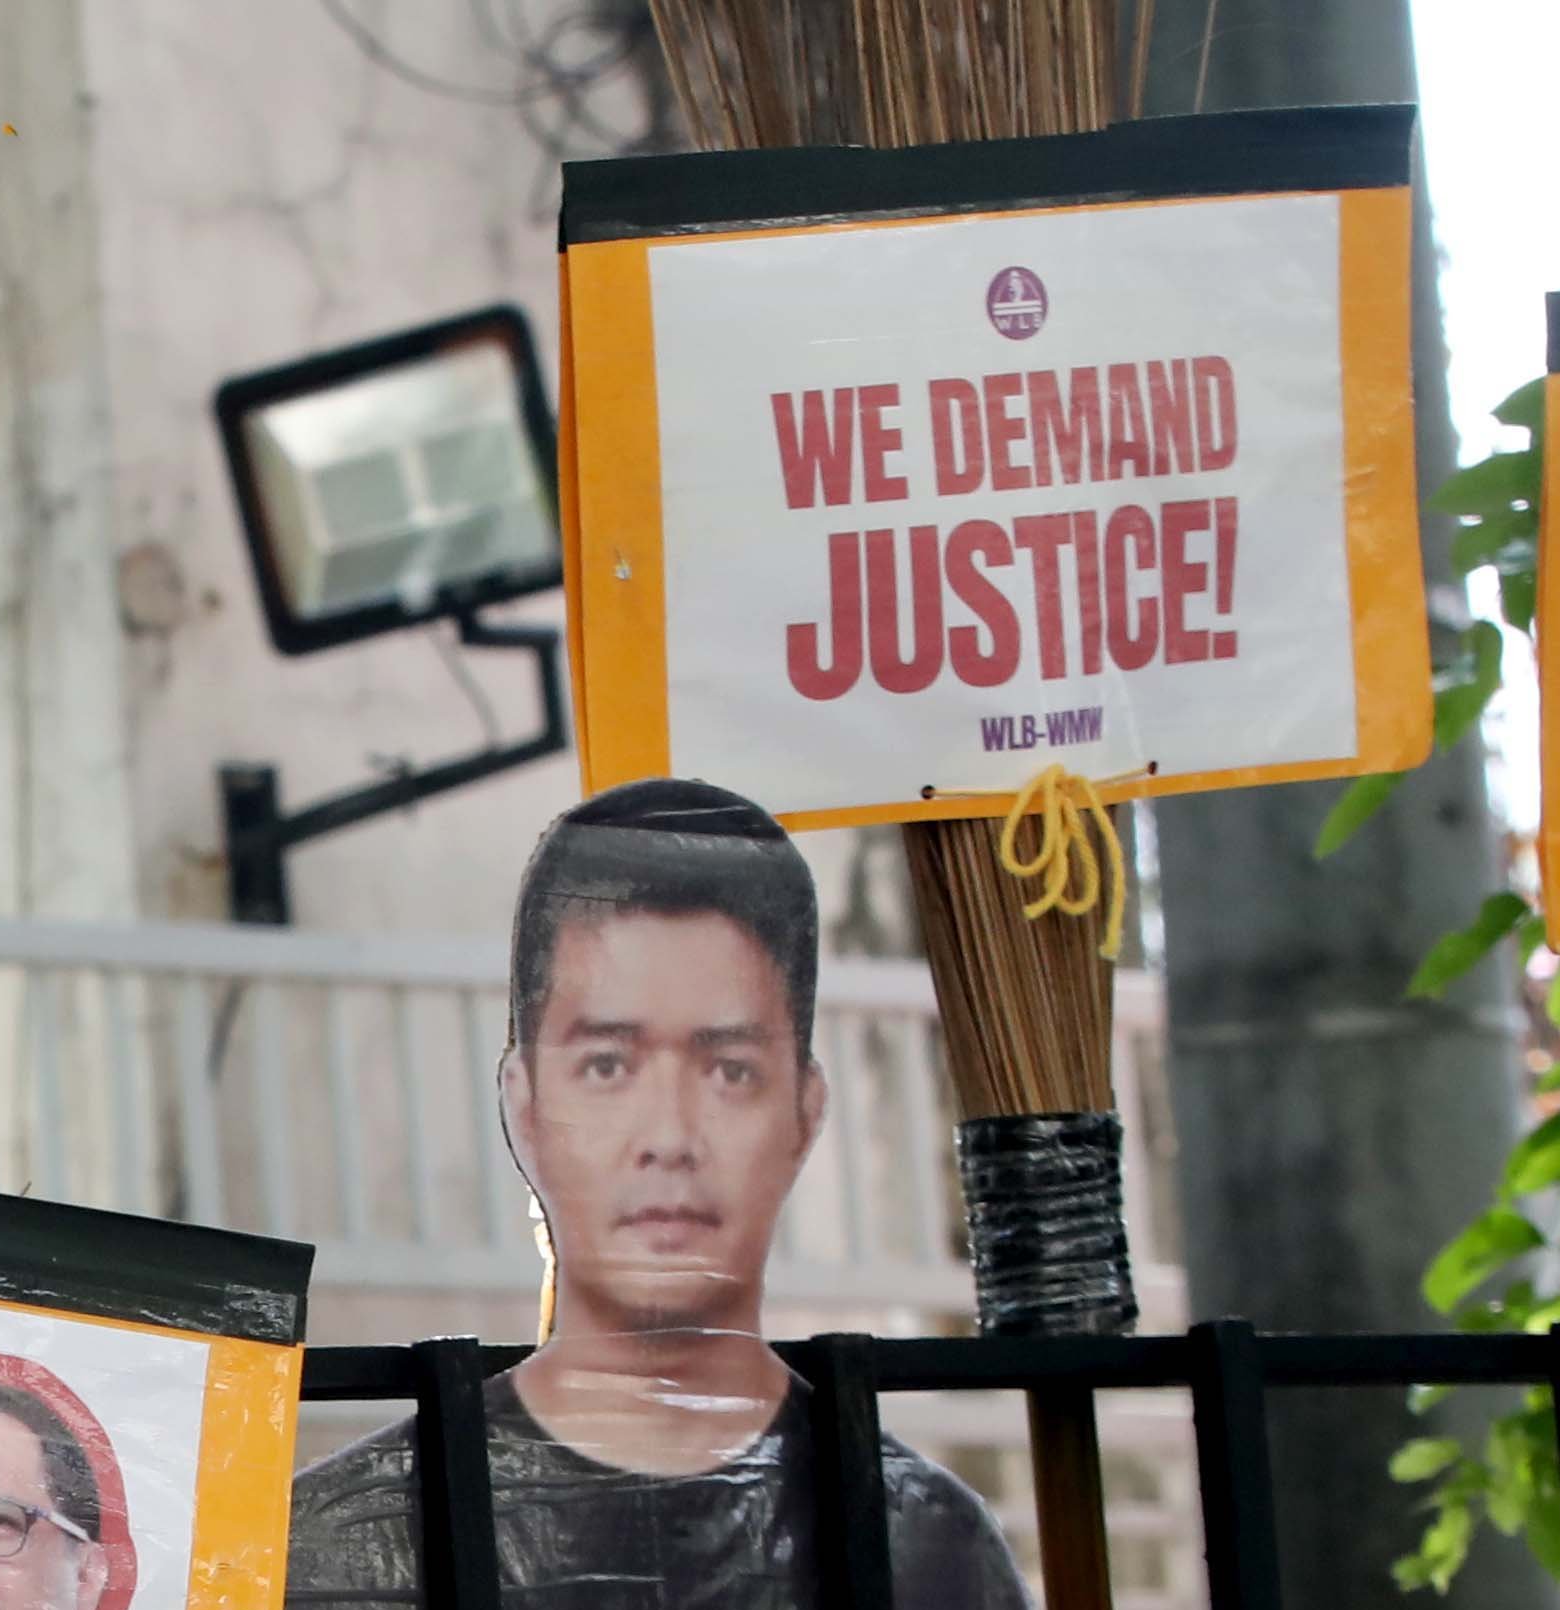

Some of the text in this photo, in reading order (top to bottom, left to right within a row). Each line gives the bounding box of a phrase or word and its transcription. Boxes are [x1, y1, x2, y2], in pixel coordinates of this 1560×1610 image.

[770, 355, 1238, 510] WE DEMAND
[786, 497, 1238, 701] JUSTICE!
[981, 707, 1103, 752] WLB-WMW
